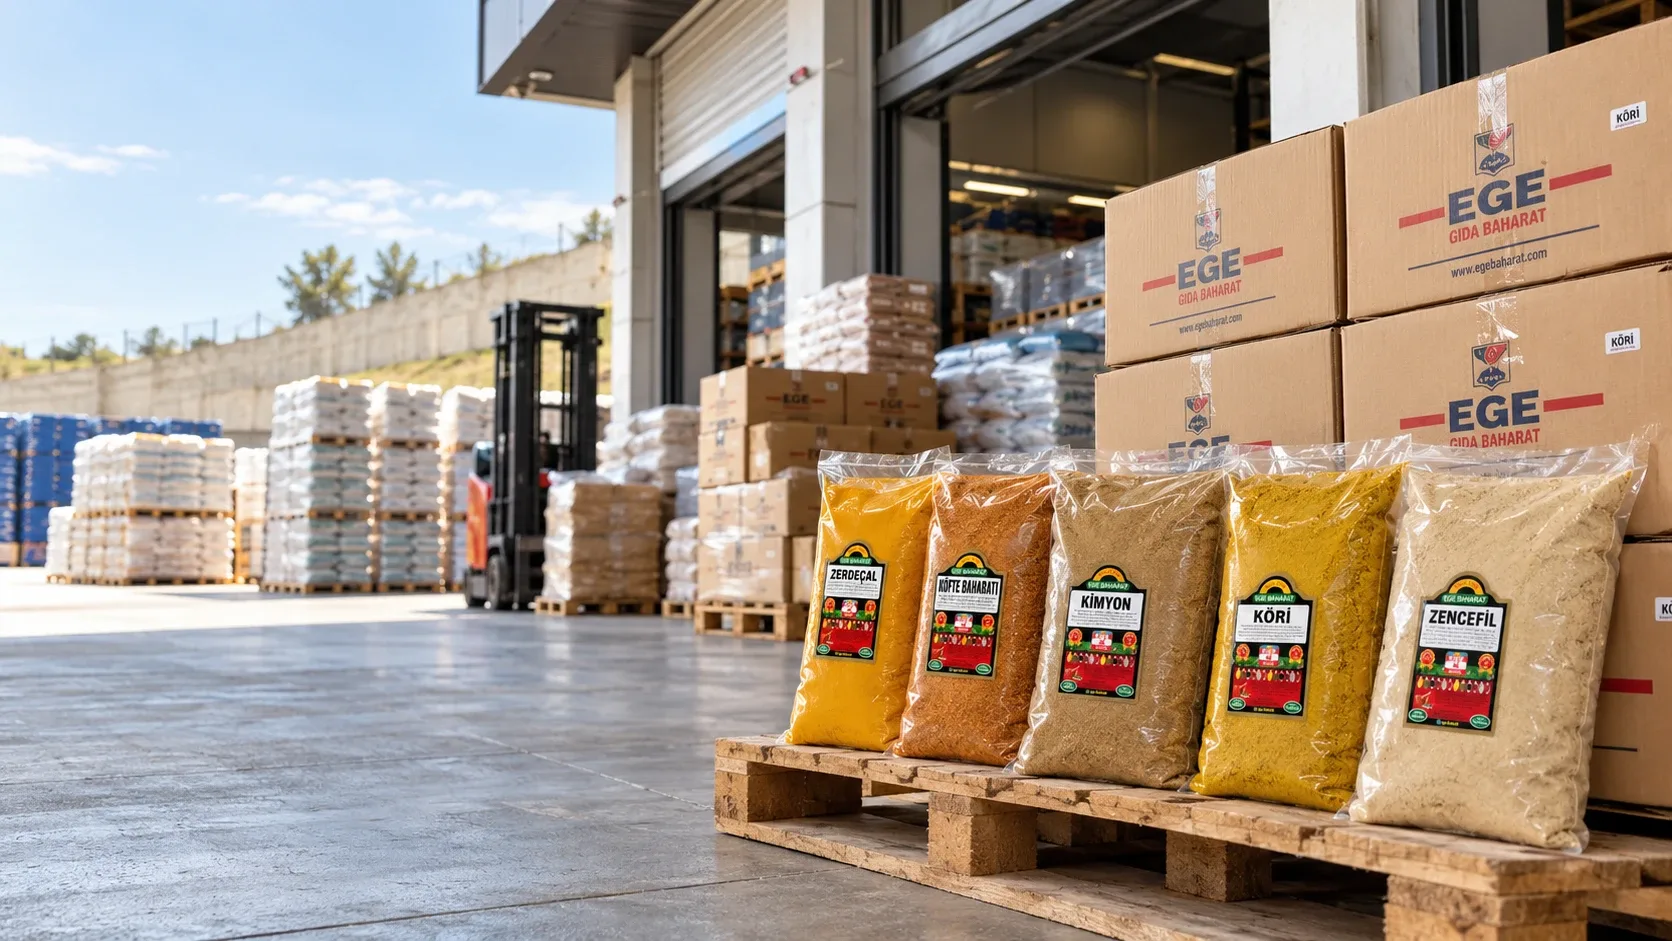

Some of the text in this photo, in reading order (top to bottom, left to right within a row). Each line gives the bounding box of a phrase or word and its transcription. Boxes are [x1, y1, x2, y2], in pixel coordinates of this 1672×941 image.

[1448, 168, 1546, 225] EGE
[1449, 207, 1546, 244] GIDA BAHARAT
[1178, 247, 1242, 290] EGE
[1451, 249, 1548, 278] www.egebaharat.com
[1178, 280, 1242, 306] GIDA BAHARAT
[1449, 389, 1540, 433] EGE
[1481, 428, 1541, 448] BAHARAT
[830, 568, 878, 585] ZERDEÇAL
[938, 577, 961, 593] KÖFTE
[1081, 592, 1132, 611] KİMYON
[1253, 606, 1292, 624] KÖRİ
[1428, 609, 1497, 627] ZENCEFİL
